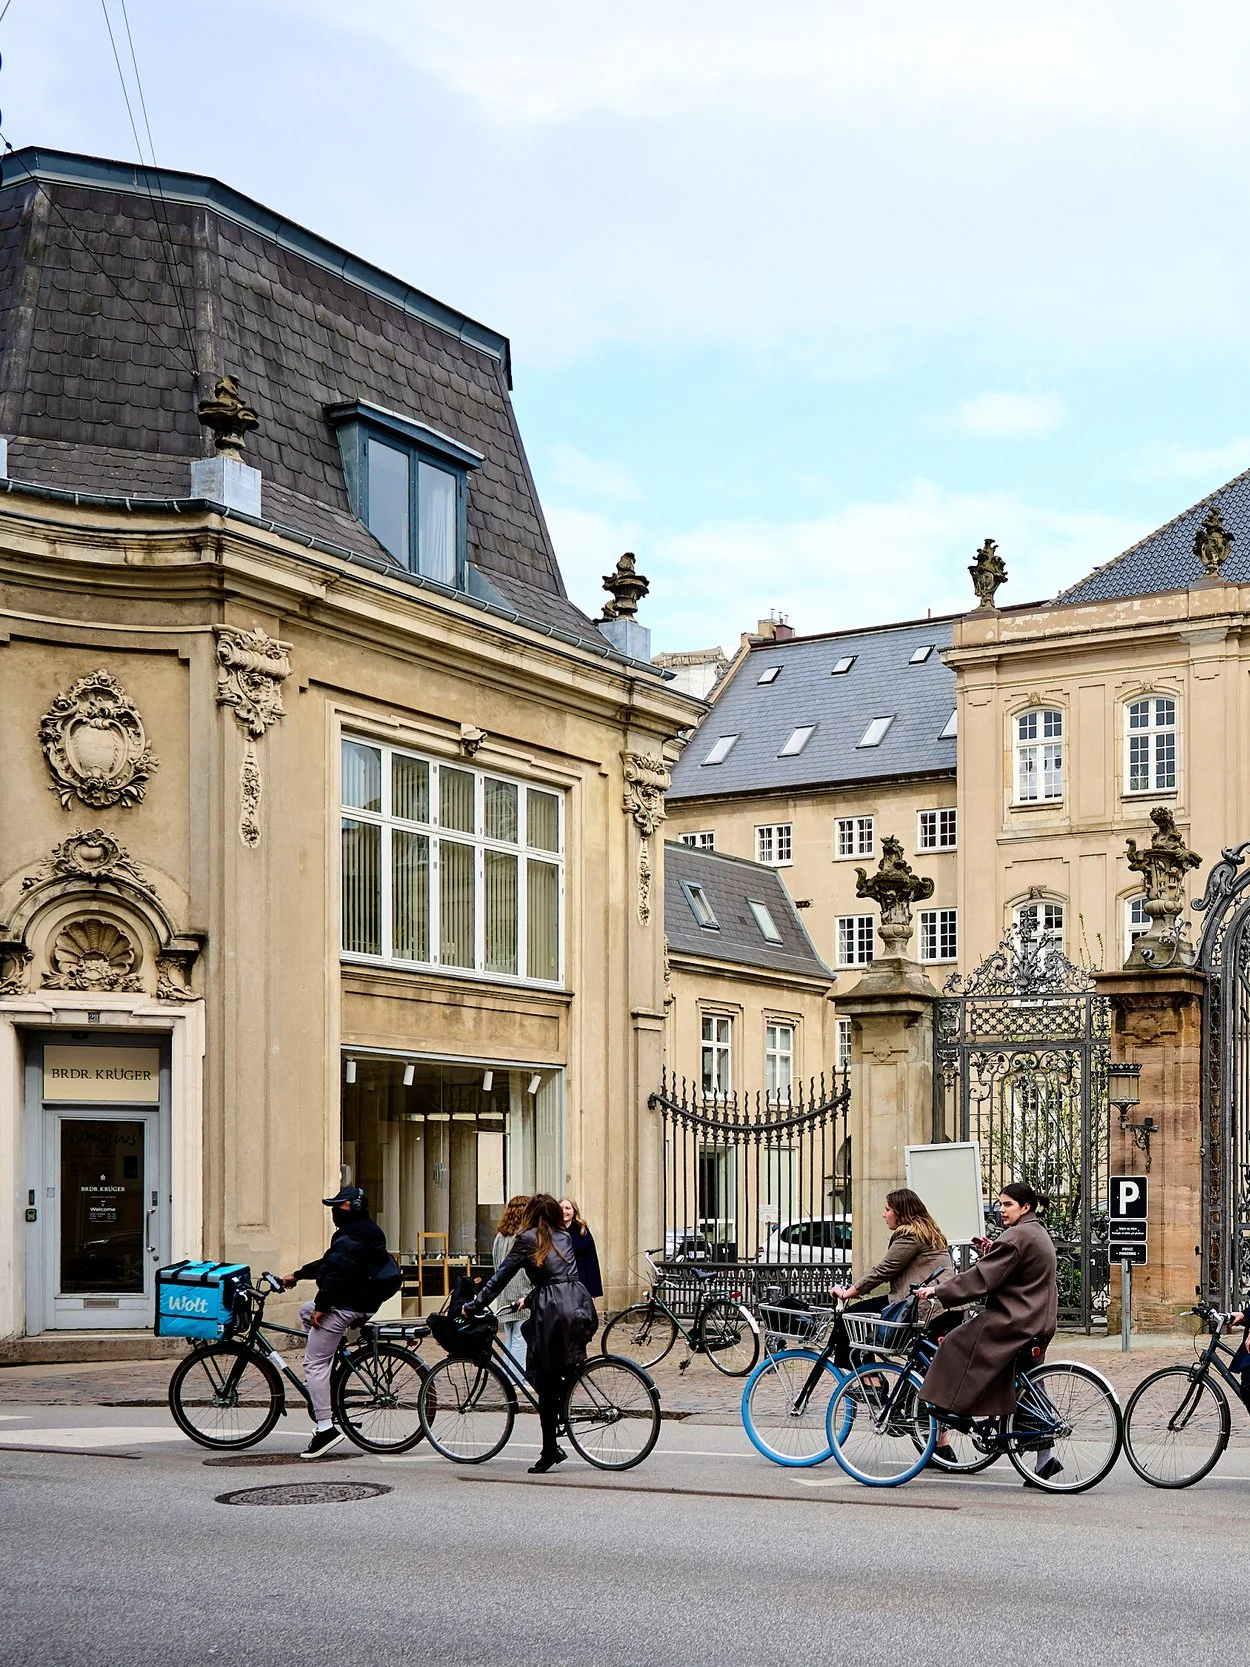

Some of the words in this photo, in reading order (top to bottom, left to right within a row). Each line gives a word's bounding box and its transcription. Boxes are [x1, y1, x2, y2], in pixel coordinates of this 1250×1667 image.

[89, 1013, 99, 1022] 28
[52, 1068, 92, 1079] BRDR.
[93, 1067, 151, 1081] KRÜGER
[1119, 1181, 1140, 1215] P
[168, 1295, 209, 1314] Wolt
